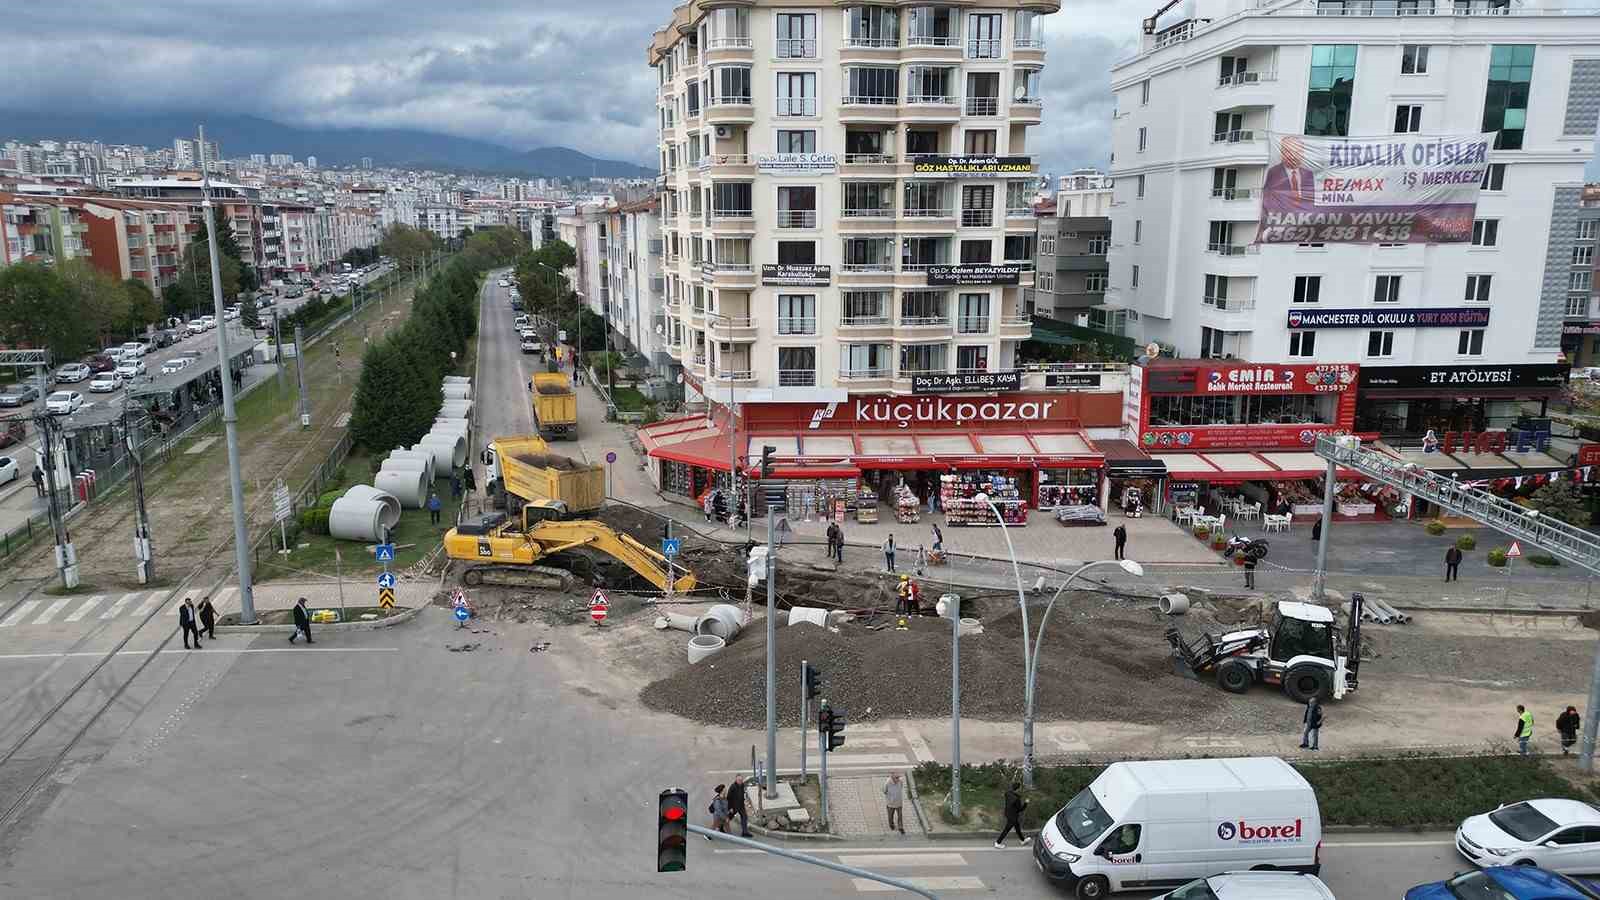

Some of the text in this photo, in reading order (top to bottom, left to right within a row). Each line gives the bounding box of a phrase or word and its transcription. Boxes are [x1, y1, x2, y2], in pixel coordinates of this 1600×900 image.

[1329, 139, 1488, 167] KİRALIK OFİSLER
[915, 163, 1031, 172] GÖZ HASTALIKLARI UZMANI
[1322, 178, 1384, 191] RE/MAX
[1402, 170, 1484, 189] İŞ MERKEZİ
[1321, 192, 1354, 203] MİNA
[1266, 211, 1344, 226] HAKAN
[1349, 211, 1417, 225] YAVUZ
[1262, 226, 1315, 243] (362)
[1318, 225, 1357, 240] 438
[1302, 313, 1360, 324] MANCHESTER
[1362, 312, 1375, 324] DİL
[1377, 313, 1407, 323] OKULU
[1408, 314, 1415, 323] &
[1416, 313, 1439, 322] YURT
[1458, 310, 1489, 322] EĞİTİM
[997, 374, 1017, 383] KAYA
[1430, 368, 1512, 383] ET ATÖLYESİ
[856, 398, 1053, 427] küçükpazar
[1239, 819, 1302, 839] borel
